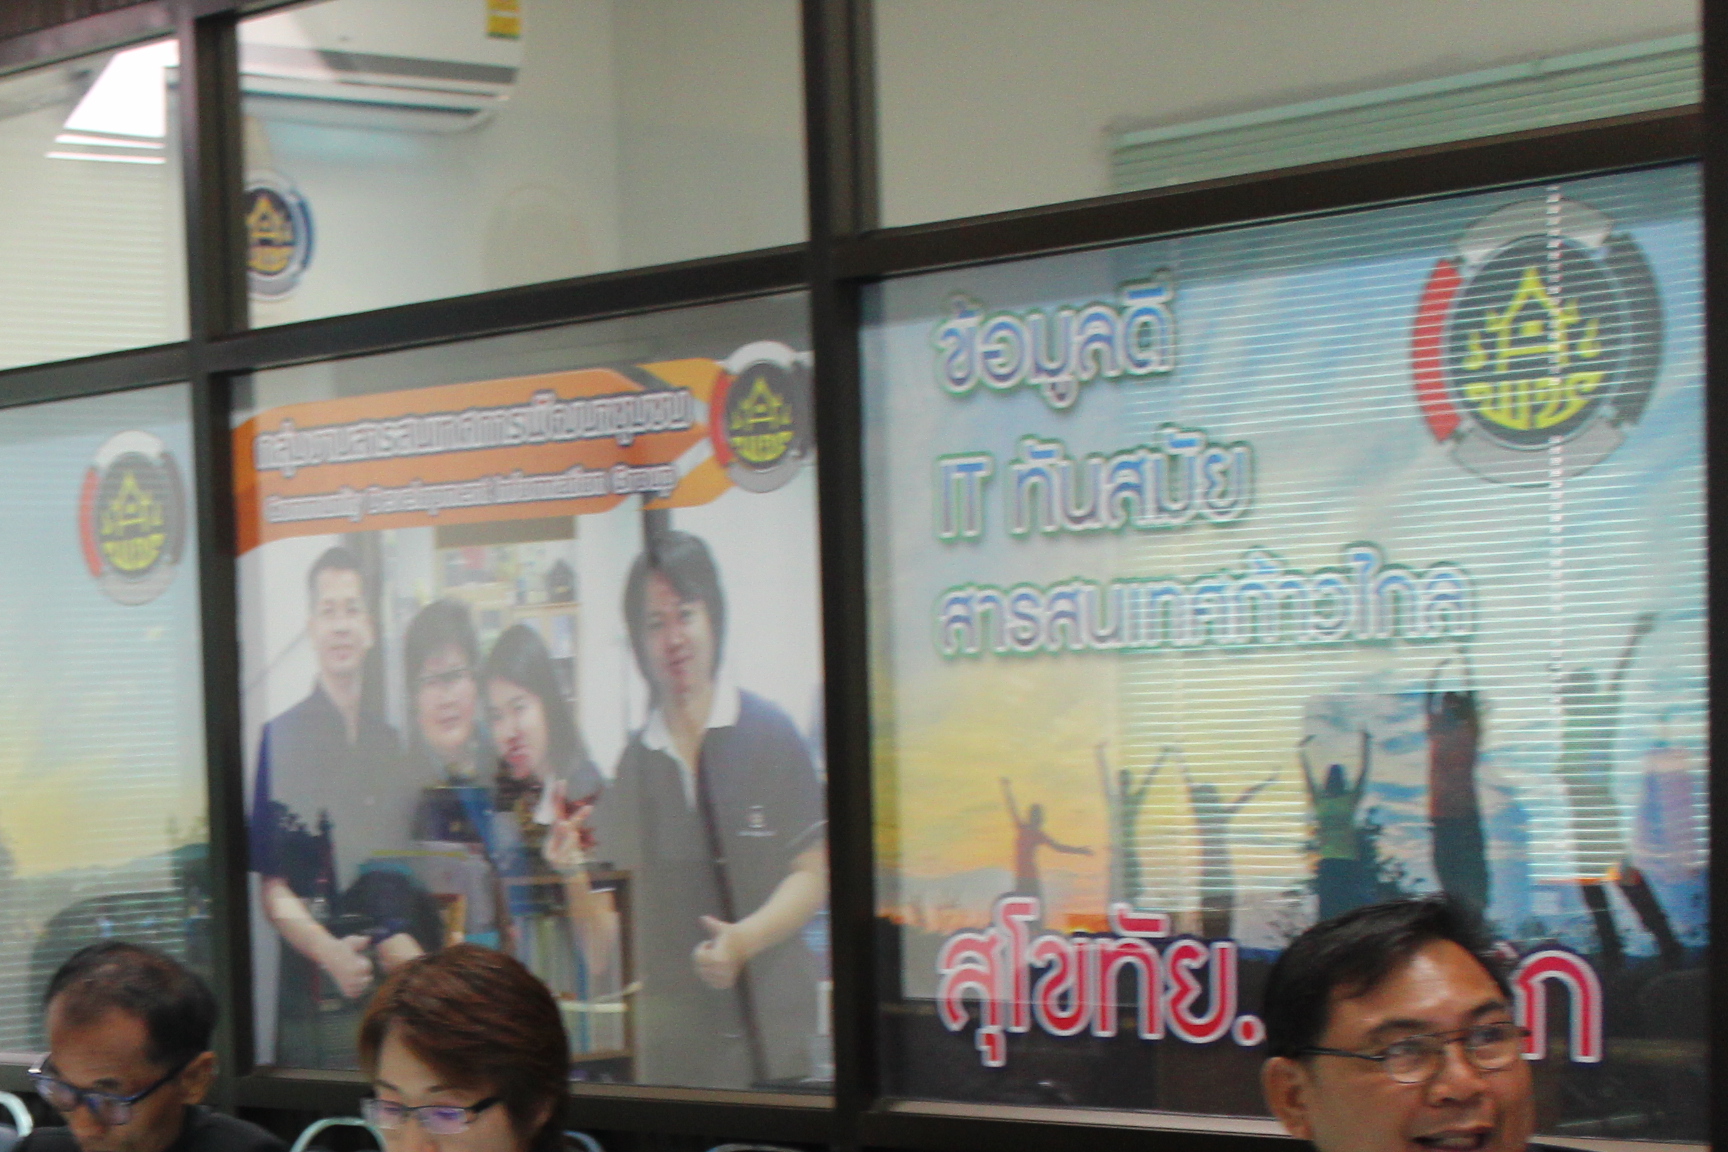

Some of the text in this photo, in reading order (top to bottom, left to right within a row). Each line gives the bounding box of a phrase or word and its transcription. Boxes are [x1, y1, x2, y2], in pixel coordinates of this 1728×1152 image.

[937, 426, 1250, 537] IT ทันสมัย
